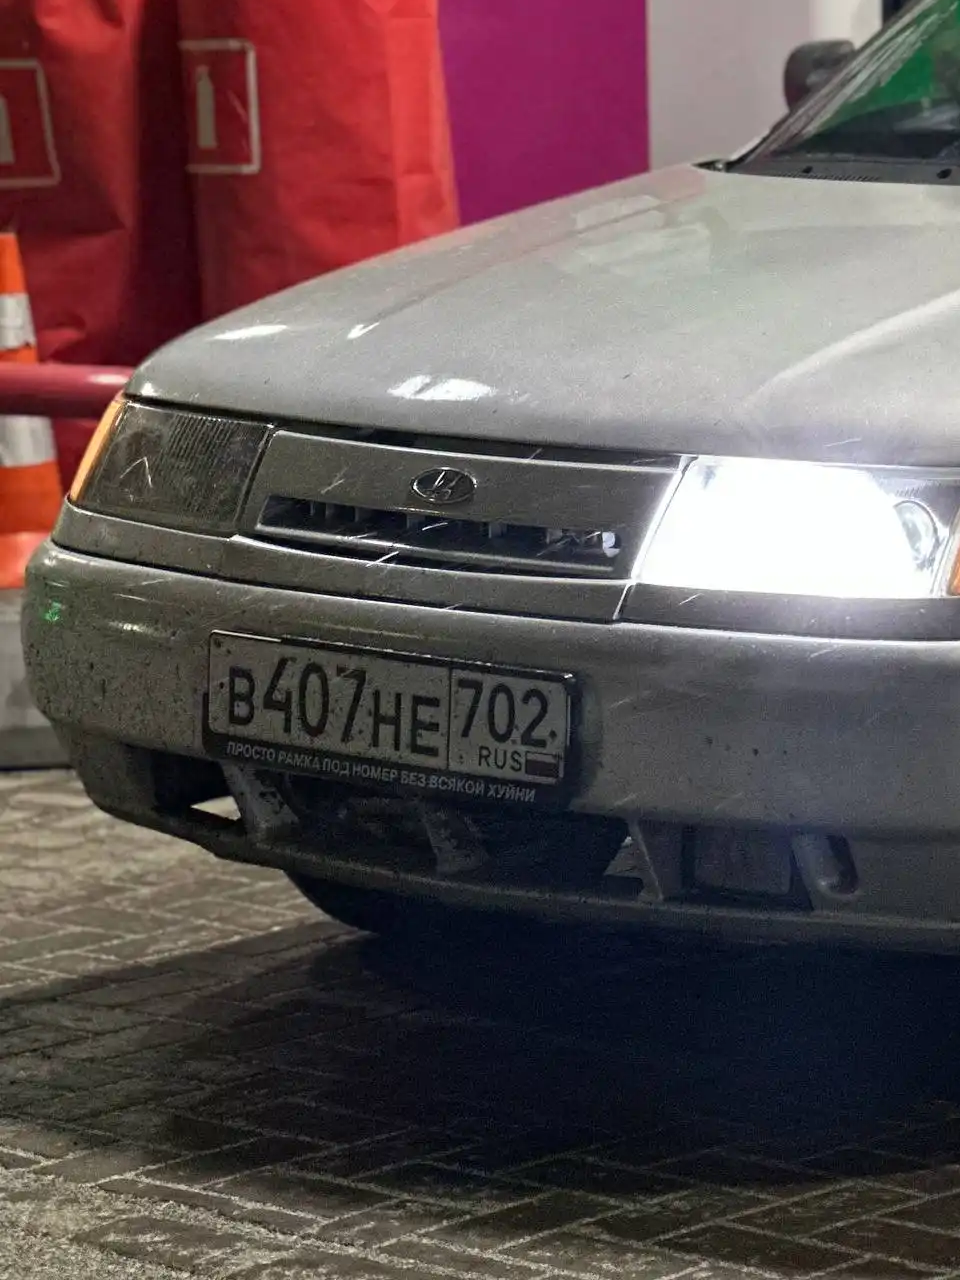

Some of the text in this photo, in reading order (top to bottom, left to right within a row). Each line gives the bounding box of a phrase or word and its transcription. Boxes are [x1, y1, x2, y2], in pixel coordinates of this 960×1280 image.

[457, 679, 549, 749] 702
[227, 741, 536, 803] ПРОСТО РАМКА ПОД НОМЕР БЕЗ ВСЯКОЙ ХУЙНИ
[477, 745, 523, 771] RUS
